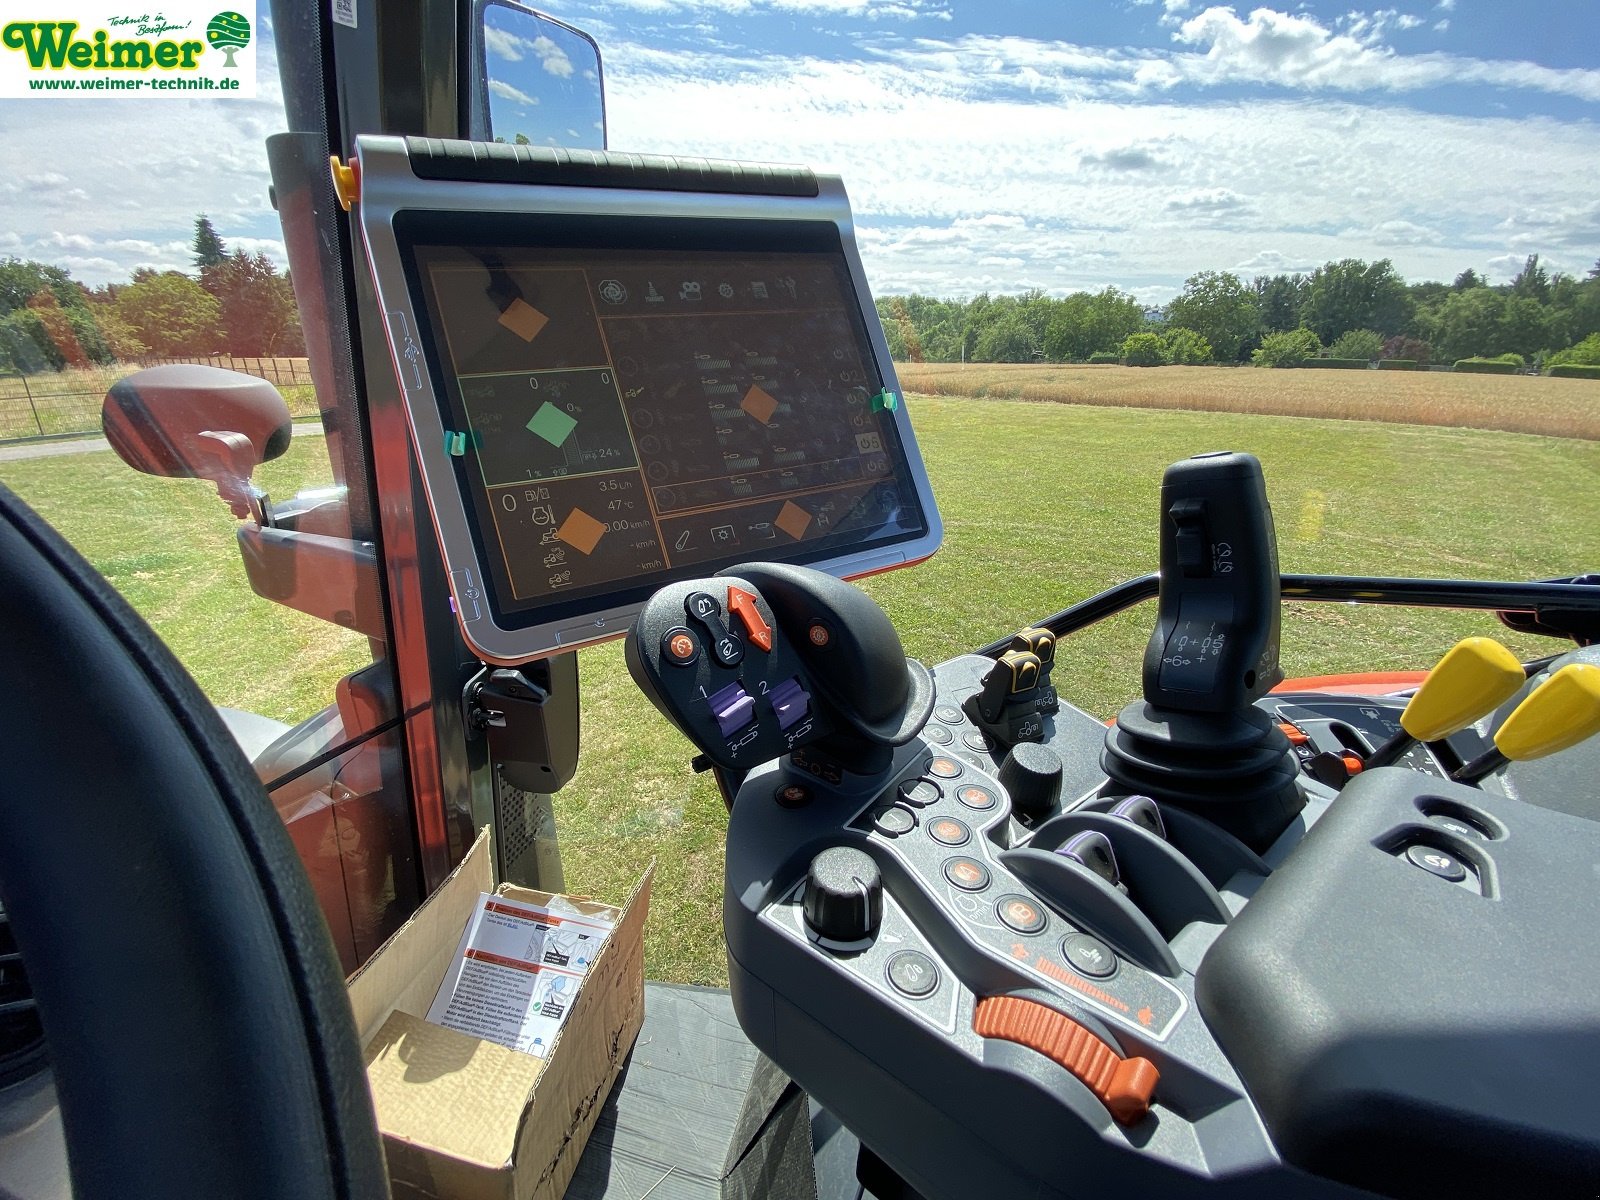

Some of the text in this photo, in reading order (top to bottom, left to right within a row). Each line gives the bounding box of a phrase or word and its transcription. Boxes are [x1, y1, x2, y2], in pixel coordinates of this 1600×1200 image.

[530, 377, 538, 390] 0
[601, 373, 610, 384] 0
[566, 402, 574, 412] 0
[598, 448, 612, 458] 24
[599, 480, 618, 492] 3.5
[502, 494, 516, 512] 0
[608, 500, 622, 510] 47
[630, 520, 650, 530] km/h
[636, 539, 656, 549] km/h
[641, 560, 662, 570] km/h
[758, 631, 770, 642] R
[1212, 639, 1224, 648] 5
[1172, 656, 1182, 666] 6
[699, 686, 708, 698] 1
[758, 680, 770, 696] 2
[960, 865, 976, 876] A
[1010, 904, 1032, 921] B
